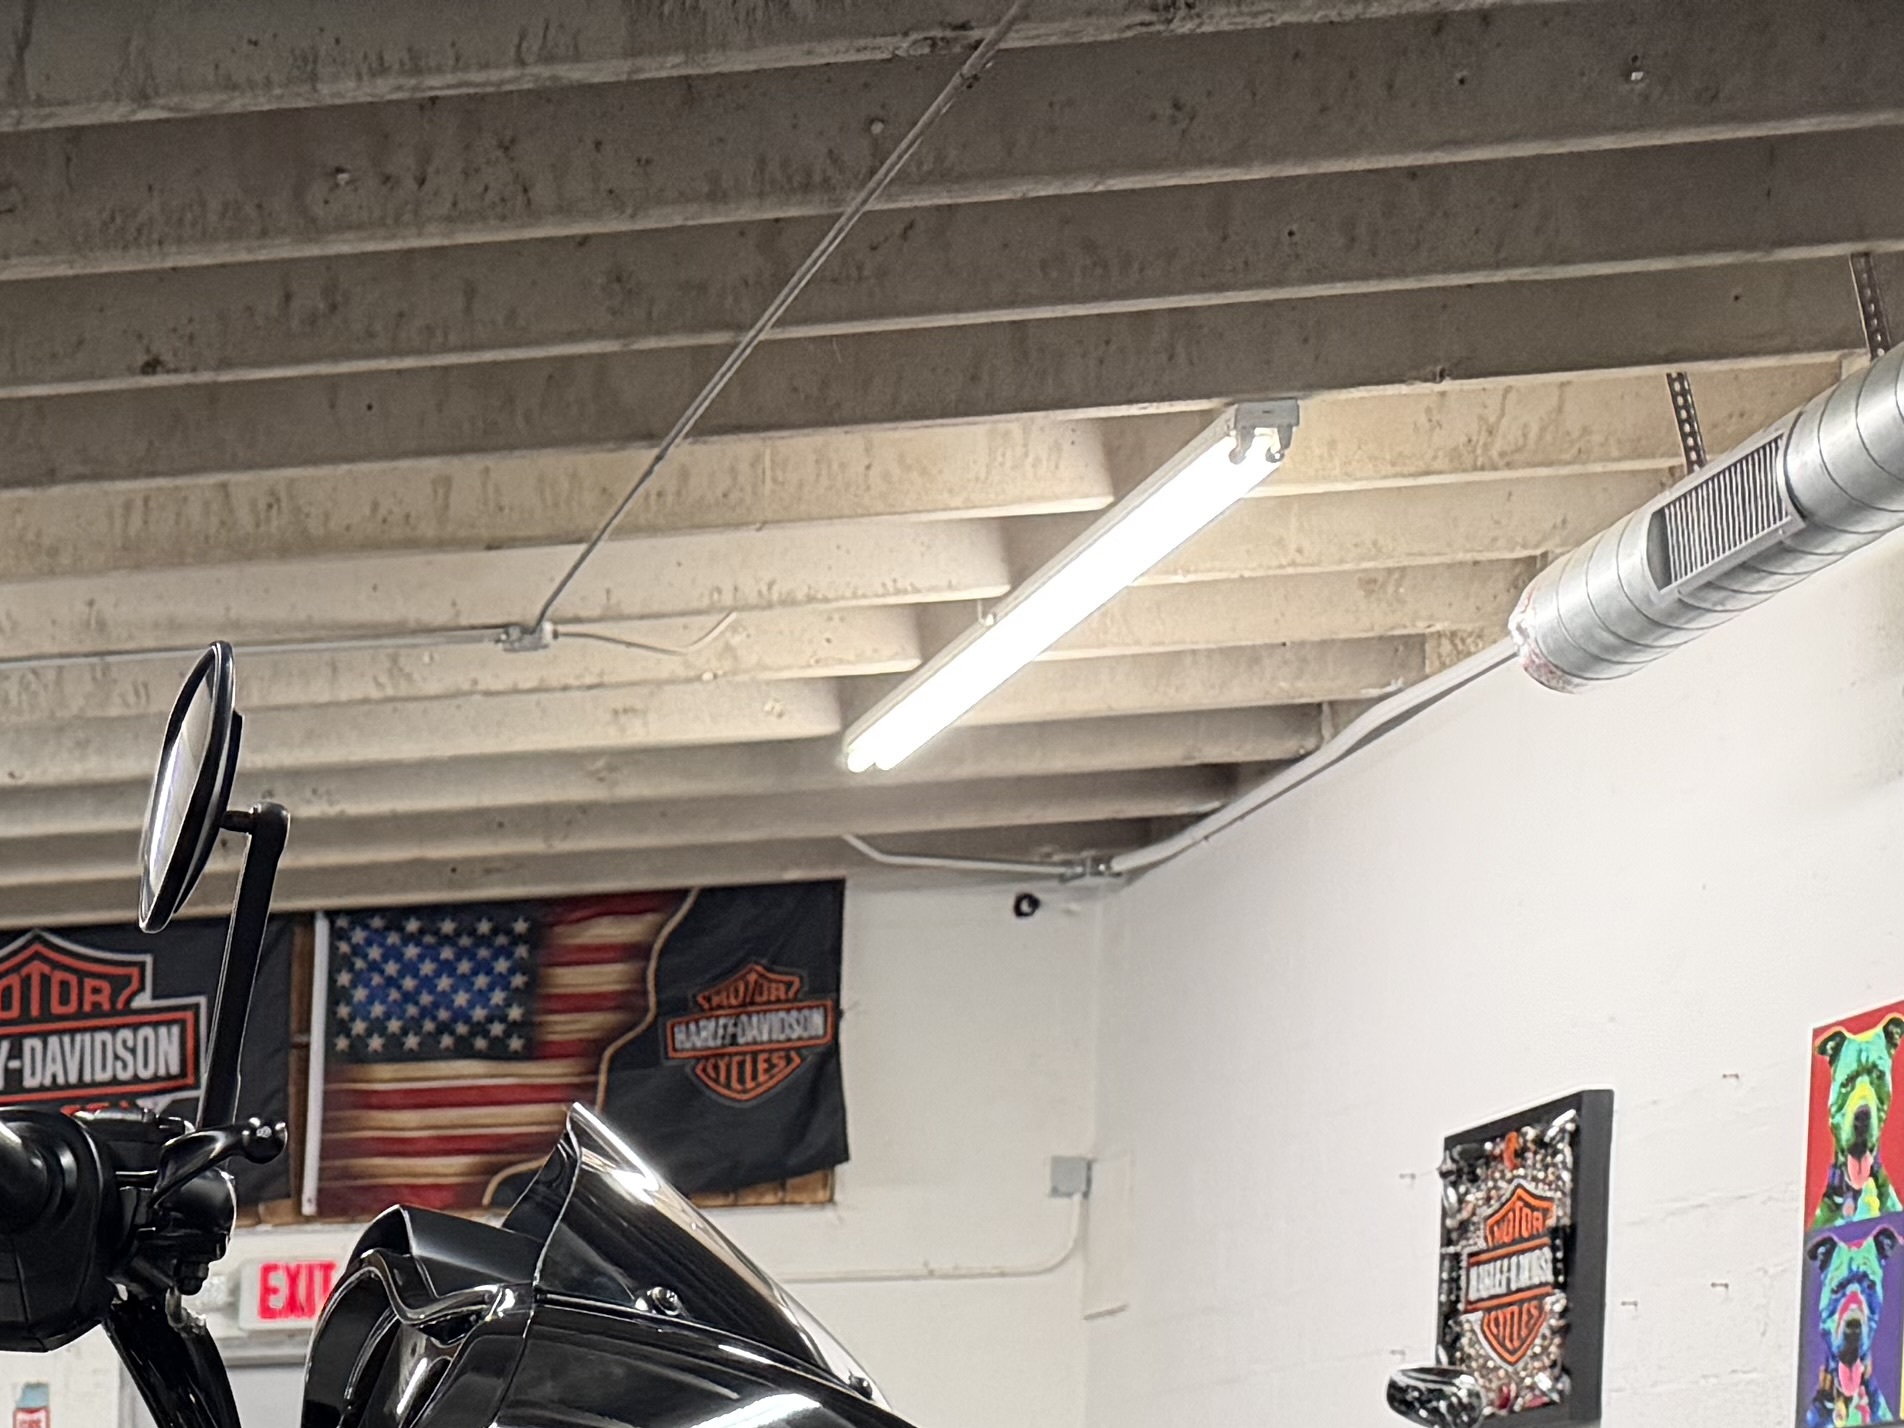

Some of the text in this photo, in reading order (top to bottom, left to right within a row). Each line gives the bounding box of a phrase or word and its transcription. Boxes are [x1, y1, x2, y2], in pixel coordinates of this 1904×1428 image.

[713, 972, 787, 1008] MOTOR
[674, 1006, 825, 1049] HARLEY-DAVIDSON
[706, 1050, 787, 1089] CYCLES
[1494, 1201, 1543, 1243] MOTOR
[259, 1262, 337, 1319] EXIT
